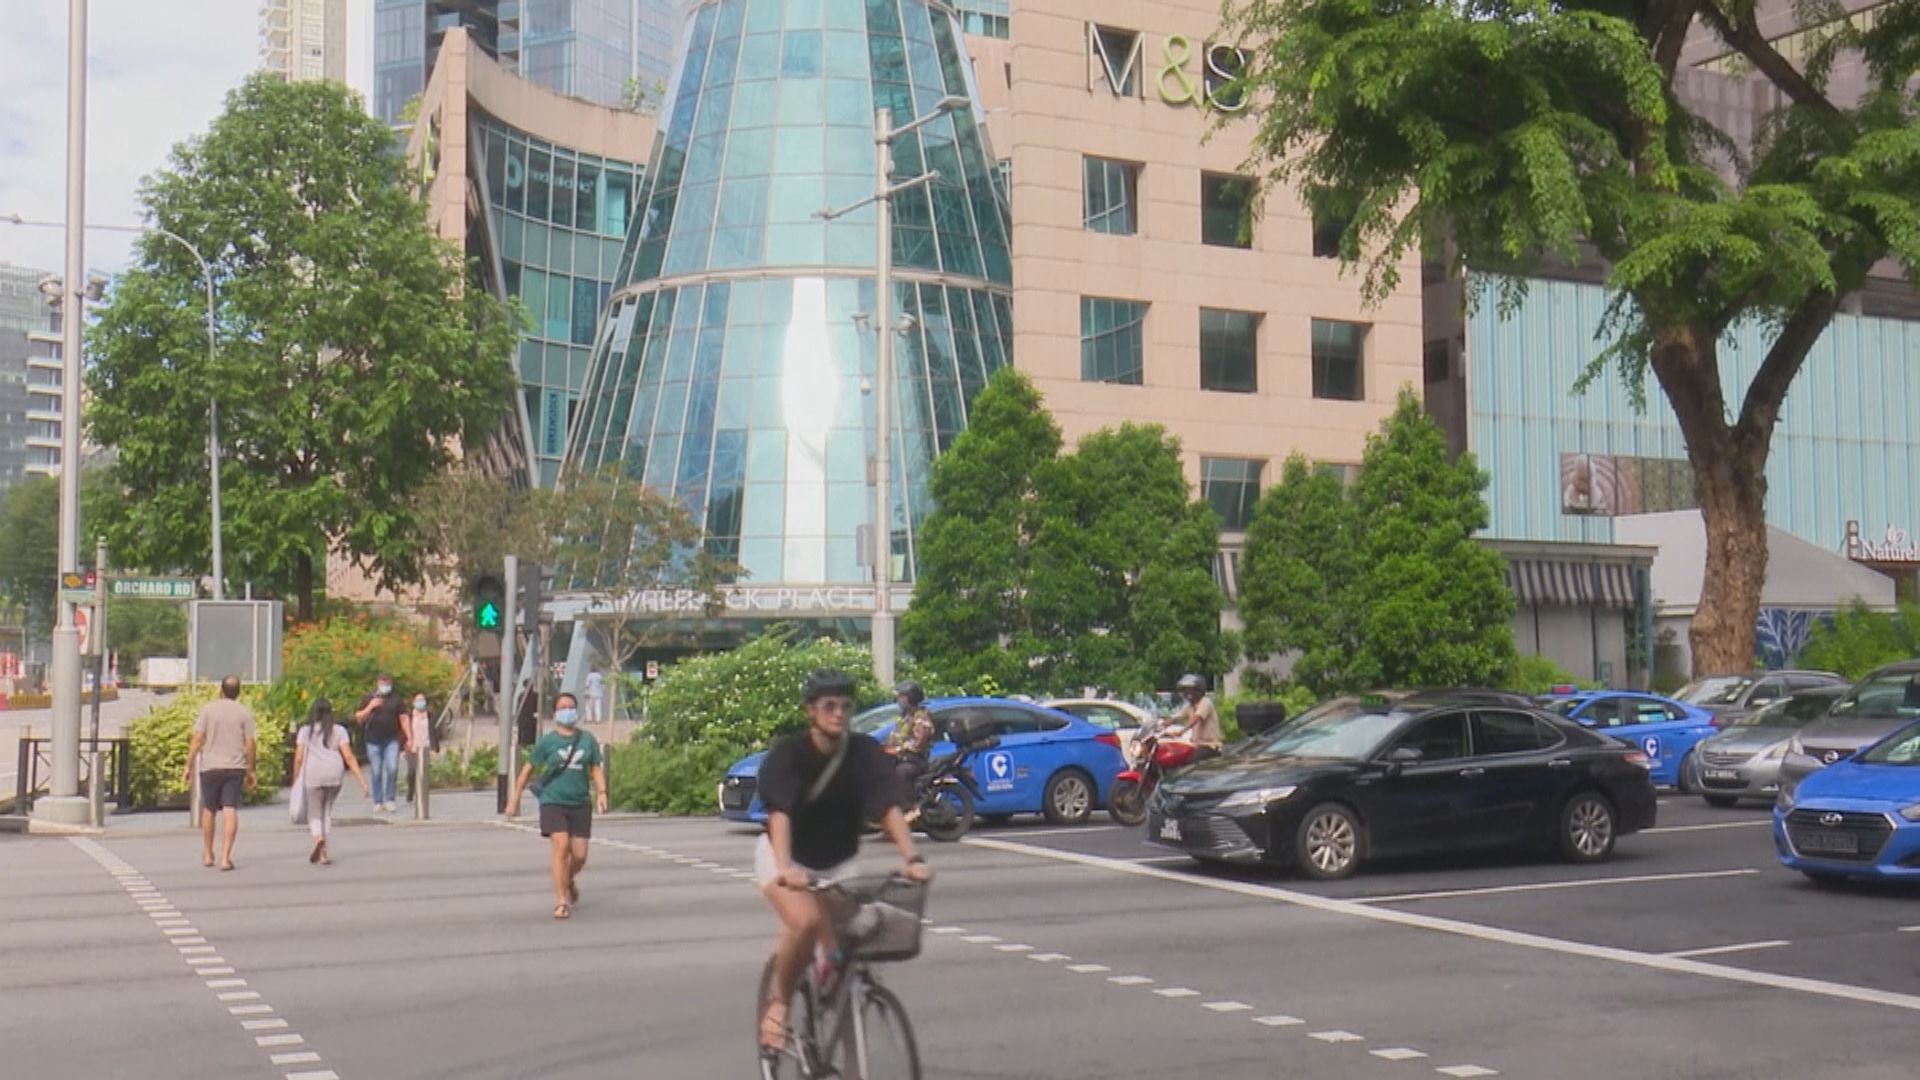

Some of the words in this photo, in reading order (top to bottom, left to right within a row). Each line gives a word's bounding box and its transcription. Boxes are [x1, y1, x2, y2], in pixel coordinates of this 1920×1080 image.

[1088, 21, 1248, 112] M&S
[114, 581, 172, 595] ORCHARD
[174, 581, 191, 595] RD
[777, 588, 863, 610] PLACE
